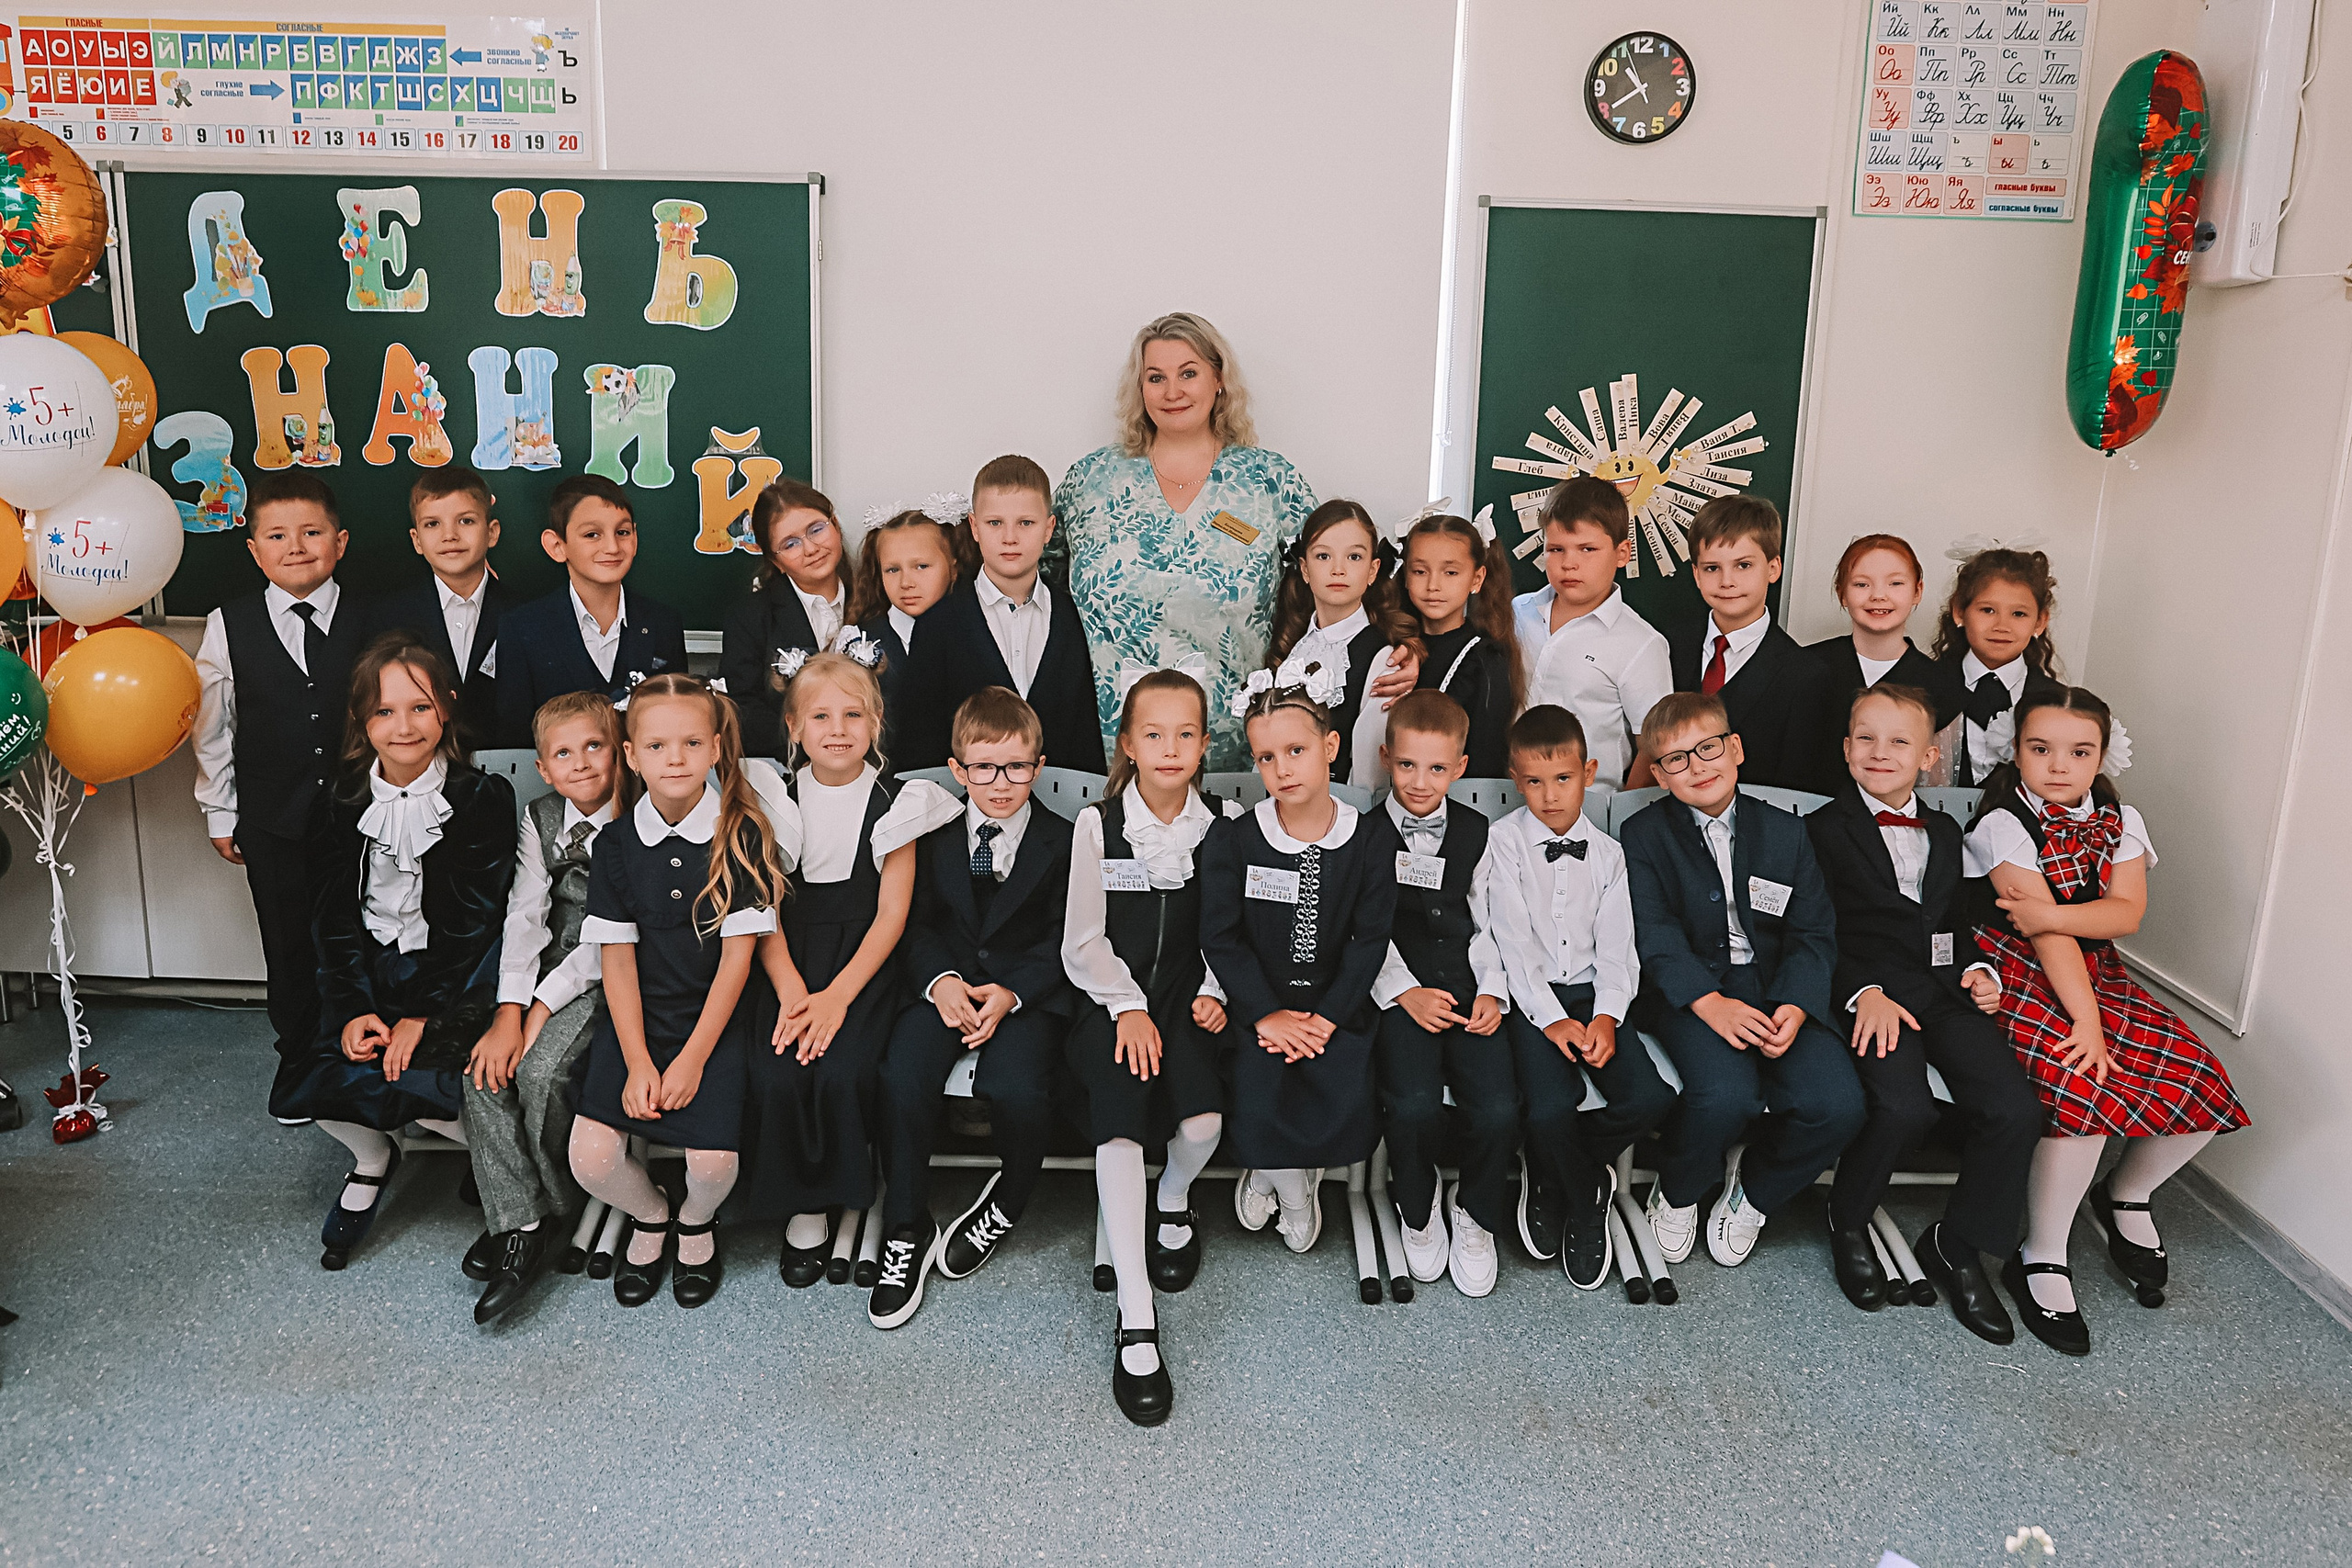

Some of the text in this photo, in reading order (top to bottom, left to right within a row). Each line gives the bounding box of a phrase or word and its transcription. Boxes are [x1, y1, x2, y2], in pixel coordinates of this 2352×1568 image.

[65, 18, 323, 32] ГЛАСНЫЕ СОГЛАСНЫЕ
[26, 37, 442, 68] А О У Ы Э Й Л М Н Р Б В Г Д Ж З
[1630, 37, 1654, 53] 12
[1659, 42, 1670, 57] 1
[1670, 57, 1685, 75] 2
[31, 72, 152, 97] Я Ё Ю И Е
[296, 81, 555, 107] П Ф К Т Ш С Х Ц Ч Щ
[1594, 79, 1606, 97] 9
[1676, 78, 1690, 96] 3
[1668, 102, 1682, 119] 4
[1612, 118, 1626, 132] 7
[1632, 121, 1646, 138] 6
[1650, 117, 1665, 134] 5
[62, 125, 578, 151] 5 6 7 8 9 10 11 12 13 14 15 16 17 18 19 20
[2030, 184, 2056, 193] буквы
[2033, 204, 2058, 213] буквы
[184, 186, 738, 333] ДЕНЬ
[28, 387, 74, 426] 5+
[1628, 397, 1639, 428] Ника
[1592, 408, 1606, 441] Саша
[1618, 399, 1628, 441] Валера
[1648, 413, 1670, 439] Вова
[1666, 412, 1690, 438] Ваня
[0, 416, 96, 450] Молодец!
[1554, 414, 1594, 459] Кристина
[1700, 424, 1741, 450] Ваня Т.
[1545, 441, 1580, 465] Марта
[1705, 446, 1747, 462] Таисия
[1518, 461, 1544, 474] Глеб
[1700, 467, 1728, 481] Лиза
[1687, 478, 1718, 496] Злата
[1672, 492, 1702, 512] Майя
[72, 520, 113, 558] 5+
[1643, 522, 1663, 561] Ксения
[1657, 513, 1679, 546] Семён
[41, 553, 129, 586] Молодец!
[1261, 882, 1290, 891] Полина
